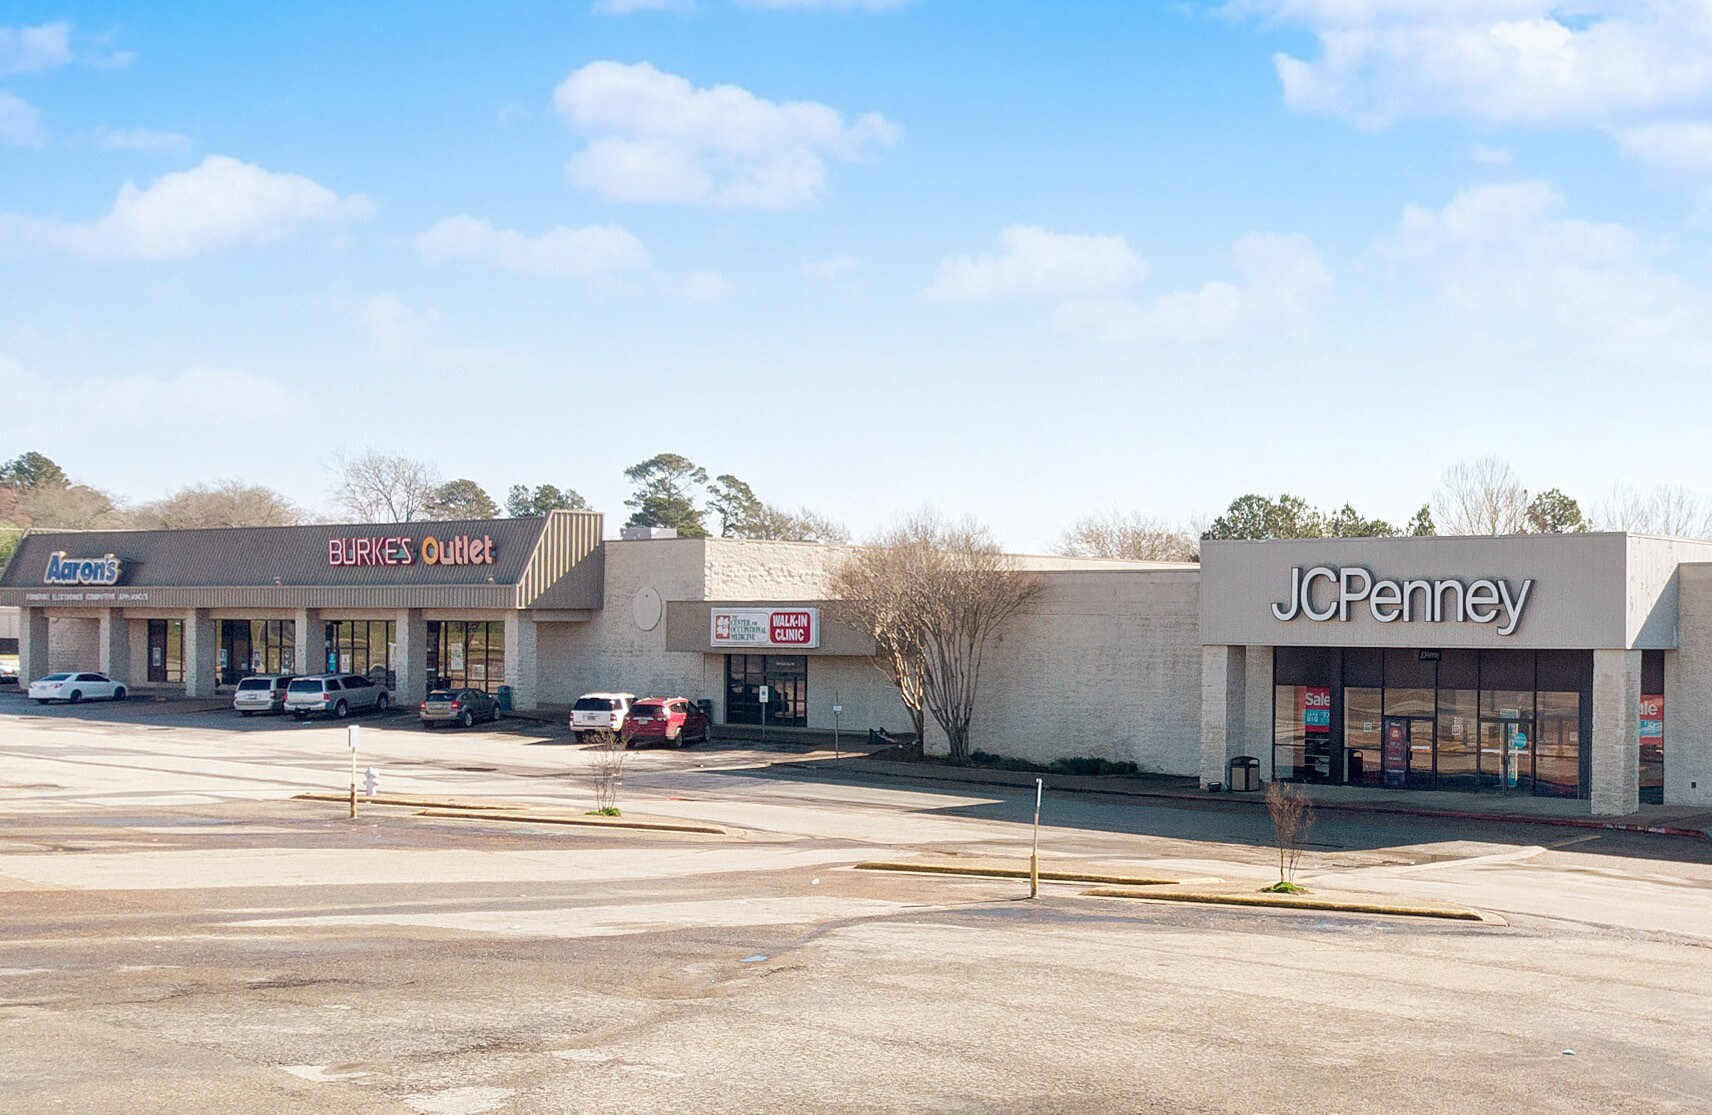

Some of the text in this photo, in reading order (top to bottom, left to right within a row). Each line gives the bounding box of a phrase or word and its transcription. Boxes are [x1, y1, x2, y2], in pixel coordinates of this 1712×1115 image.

[328, 535, 493, 566] BURKE'S Outlet
[45, 553, 118, 583] Aaron's
[1271, 566, 1535, 636] JCPenney
[773, 615, 807, 627] WALK-IN
[775, 629, 804, 641] CLINIC
[1305, 692, 1330, 706] Sale
